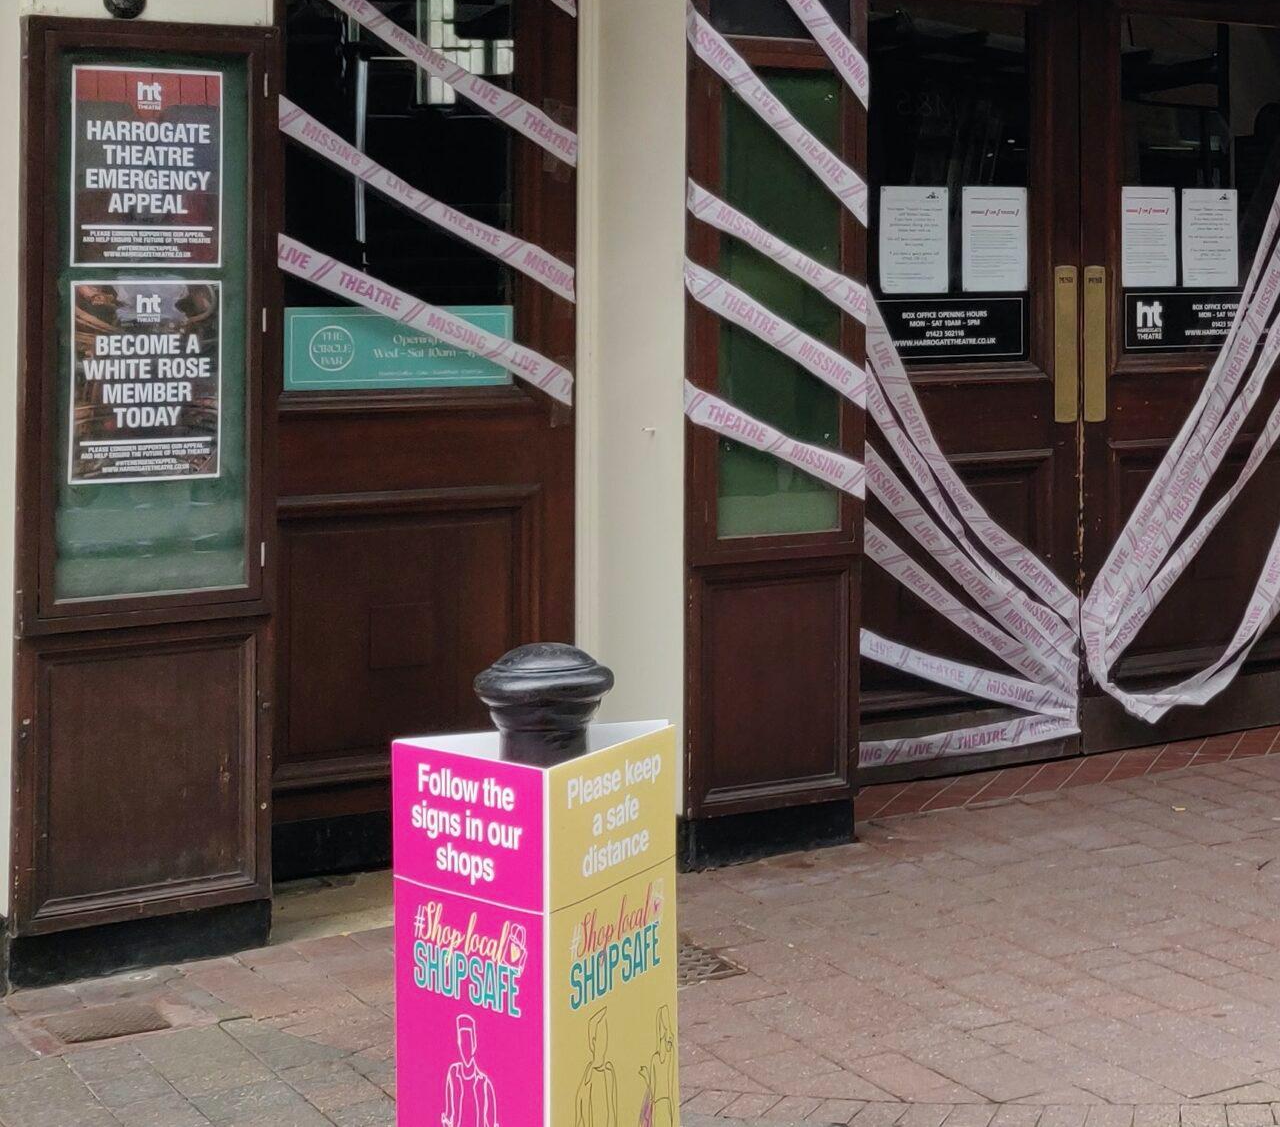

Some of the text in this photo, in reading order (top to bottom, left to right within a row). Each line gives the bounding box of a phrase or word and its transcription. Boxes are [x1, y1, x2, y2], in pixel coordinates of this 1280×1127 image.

[825, 32, 867, 90] MISSING
[389, 26, 448, 73] MISSING
[468, 75, 502, 107] LIVE
[521, 108, 576, 157] THEATRE
[86, 120, 211, 144] HARROGATE
[103, 145, 194, 167] THEATRE
[749, 86, 848, 185] LIVE THEATRE
[86, 169, 211, 191] EMERGENCY
[108, 193, 188, 214] APPEAL
[300, 119, 503, 249] MISSING LIVE THEATRE
[716, 205, 823, 281] MISSING LIVE
[277, 242, 542, 378] LIVE THEATRE MISSING LIVE
[916, 311, 936, 319] OFFICE
[966, 310, 987, 318] HOURS
[96, 334, 200, 356] BECOME A
[720, 290, 852, 385] THEATRE MISSING
[1223, 334, 1252, 387] THEATRE
[83, 357, 210, 380] WHITE ROSE
[103, 382, 192, 403] MEMBER
[113, 406, 181, 428] TODAY
[872, 341, 931, 447] LIVE THEATRE
[706, 403, 847, 480] THEATRE MISSING
[1168, 450, 1202, 500] MISSING
[1170, 411, 1241, 524] THEATRE MISSING
[980, 526, 1058, 593] LIVE THEATRE
[1109, 547, 1130, 576] LIVE
[1157, 567, 1179, 593] LIVE
[912, 521, 1046, 649] LIVE THEATRE MISSING
[902, 565, 1046, 677] THEATRE LIVE
[986, 678, 1034, 702] MISSING
[907, 727, 1008, 757] LIVE THEATRE
[417, 763, 515, 812] Follow the
[566, 752, 662, 810] Please keep
[411, 803, 523, 851] signs in our
[592, 800, 640, 837] a safe
[436, 841, 495, 886] shops
[582, 828, 650, 879] distance
[413, 900, 510, 964] #Shop local
[616, 883, 654, 942] local
